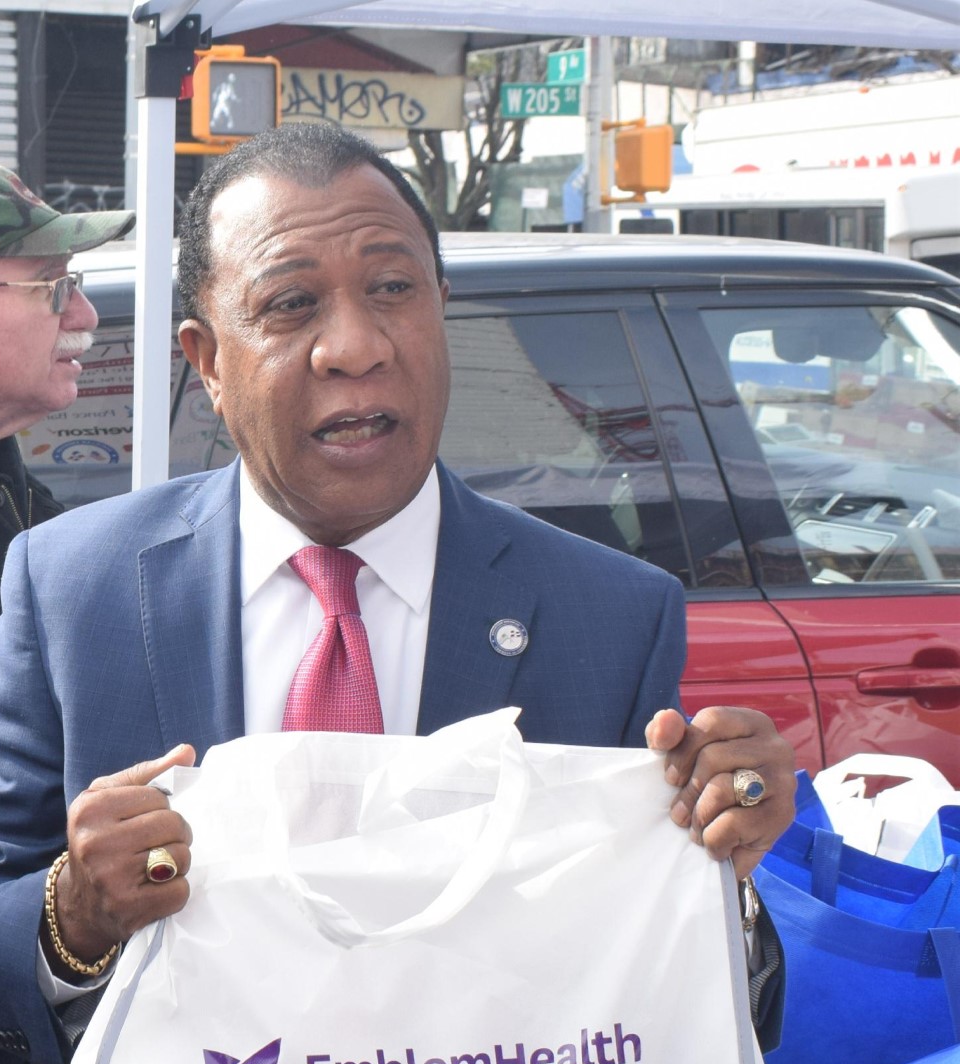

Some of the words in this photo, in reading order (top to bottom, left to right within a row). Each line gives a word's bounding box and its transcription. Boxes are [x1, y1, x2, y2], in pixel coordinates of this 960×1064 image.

[559, 56, 568, 81] 9
[507, 88, 522, 114] W
[525, 87, 561, 114] 205
